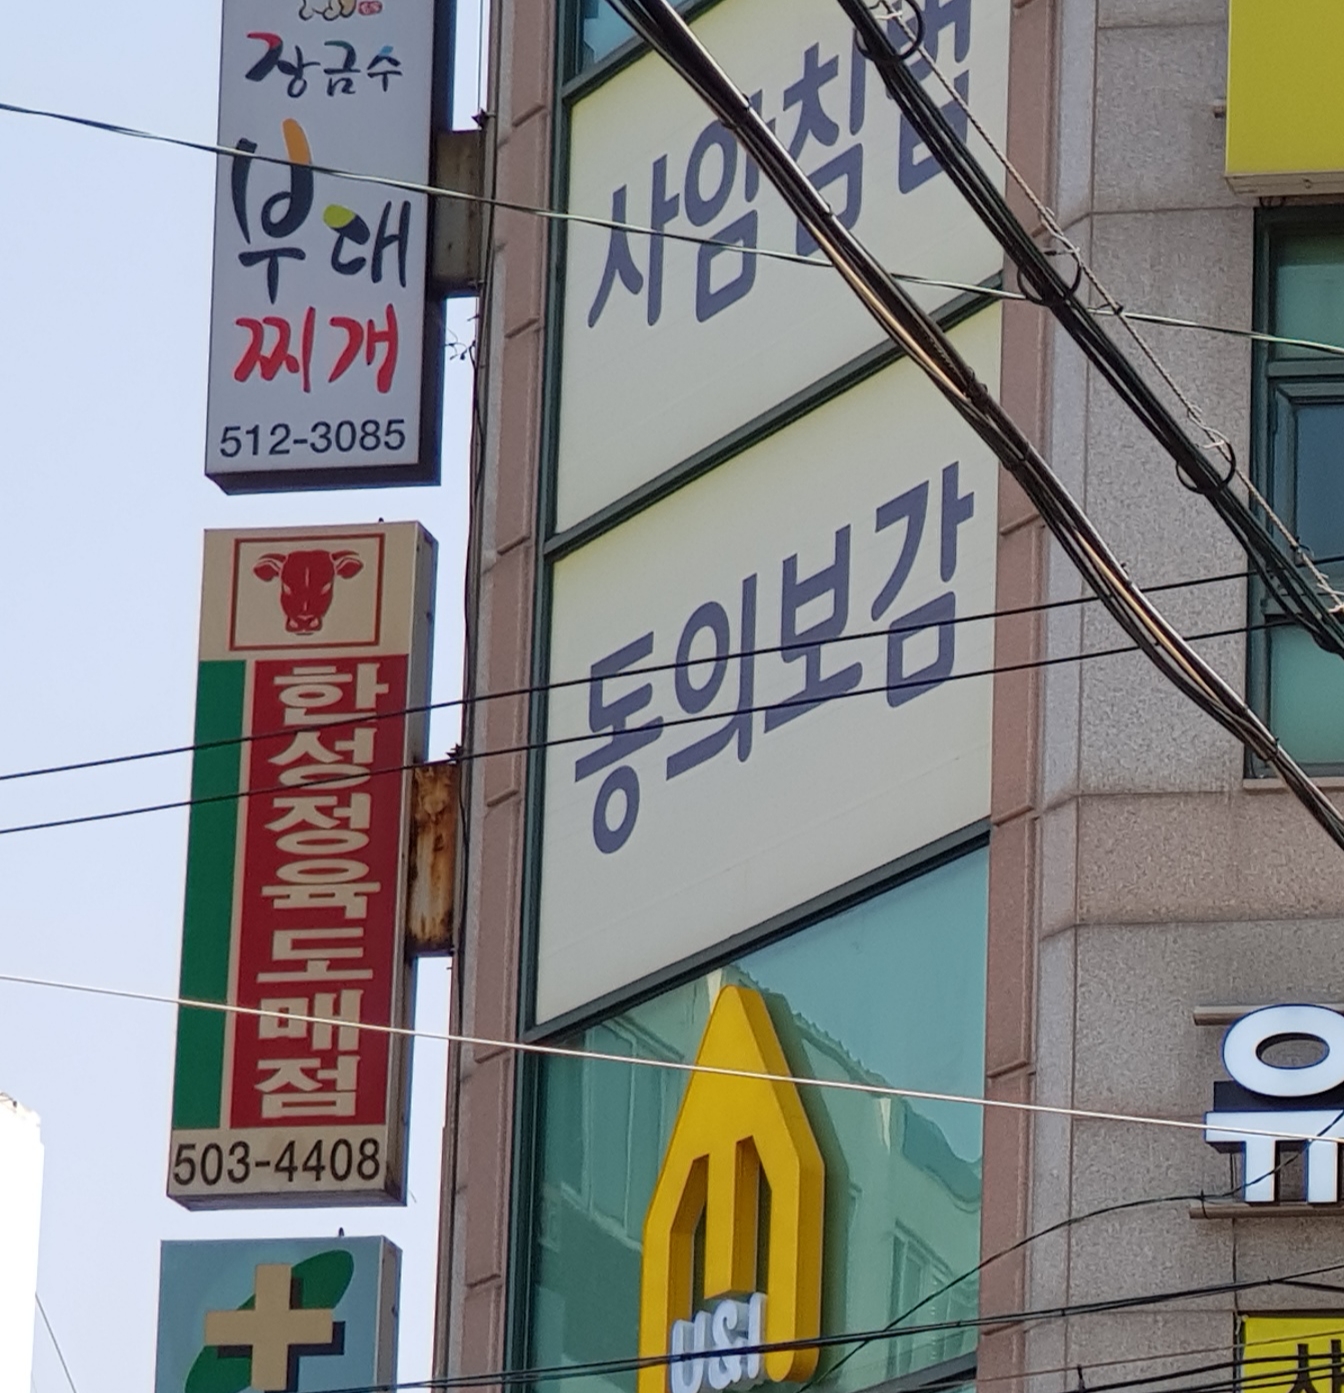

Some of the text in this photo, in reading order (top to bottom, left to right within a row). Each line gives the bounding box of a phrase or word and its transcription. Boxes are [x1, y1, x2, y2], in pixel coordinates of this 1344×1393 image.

[245, 31, 403, 98] 장금수
[234, 304, 399, 394] 찌개
[219, 418, 407, 459] 512-3085
[575, 461, 976, 855] 동의보감
[254, 662, 389, 1119] 한성정육도매점
[172, 1136, 381, 1186] 503-4408
